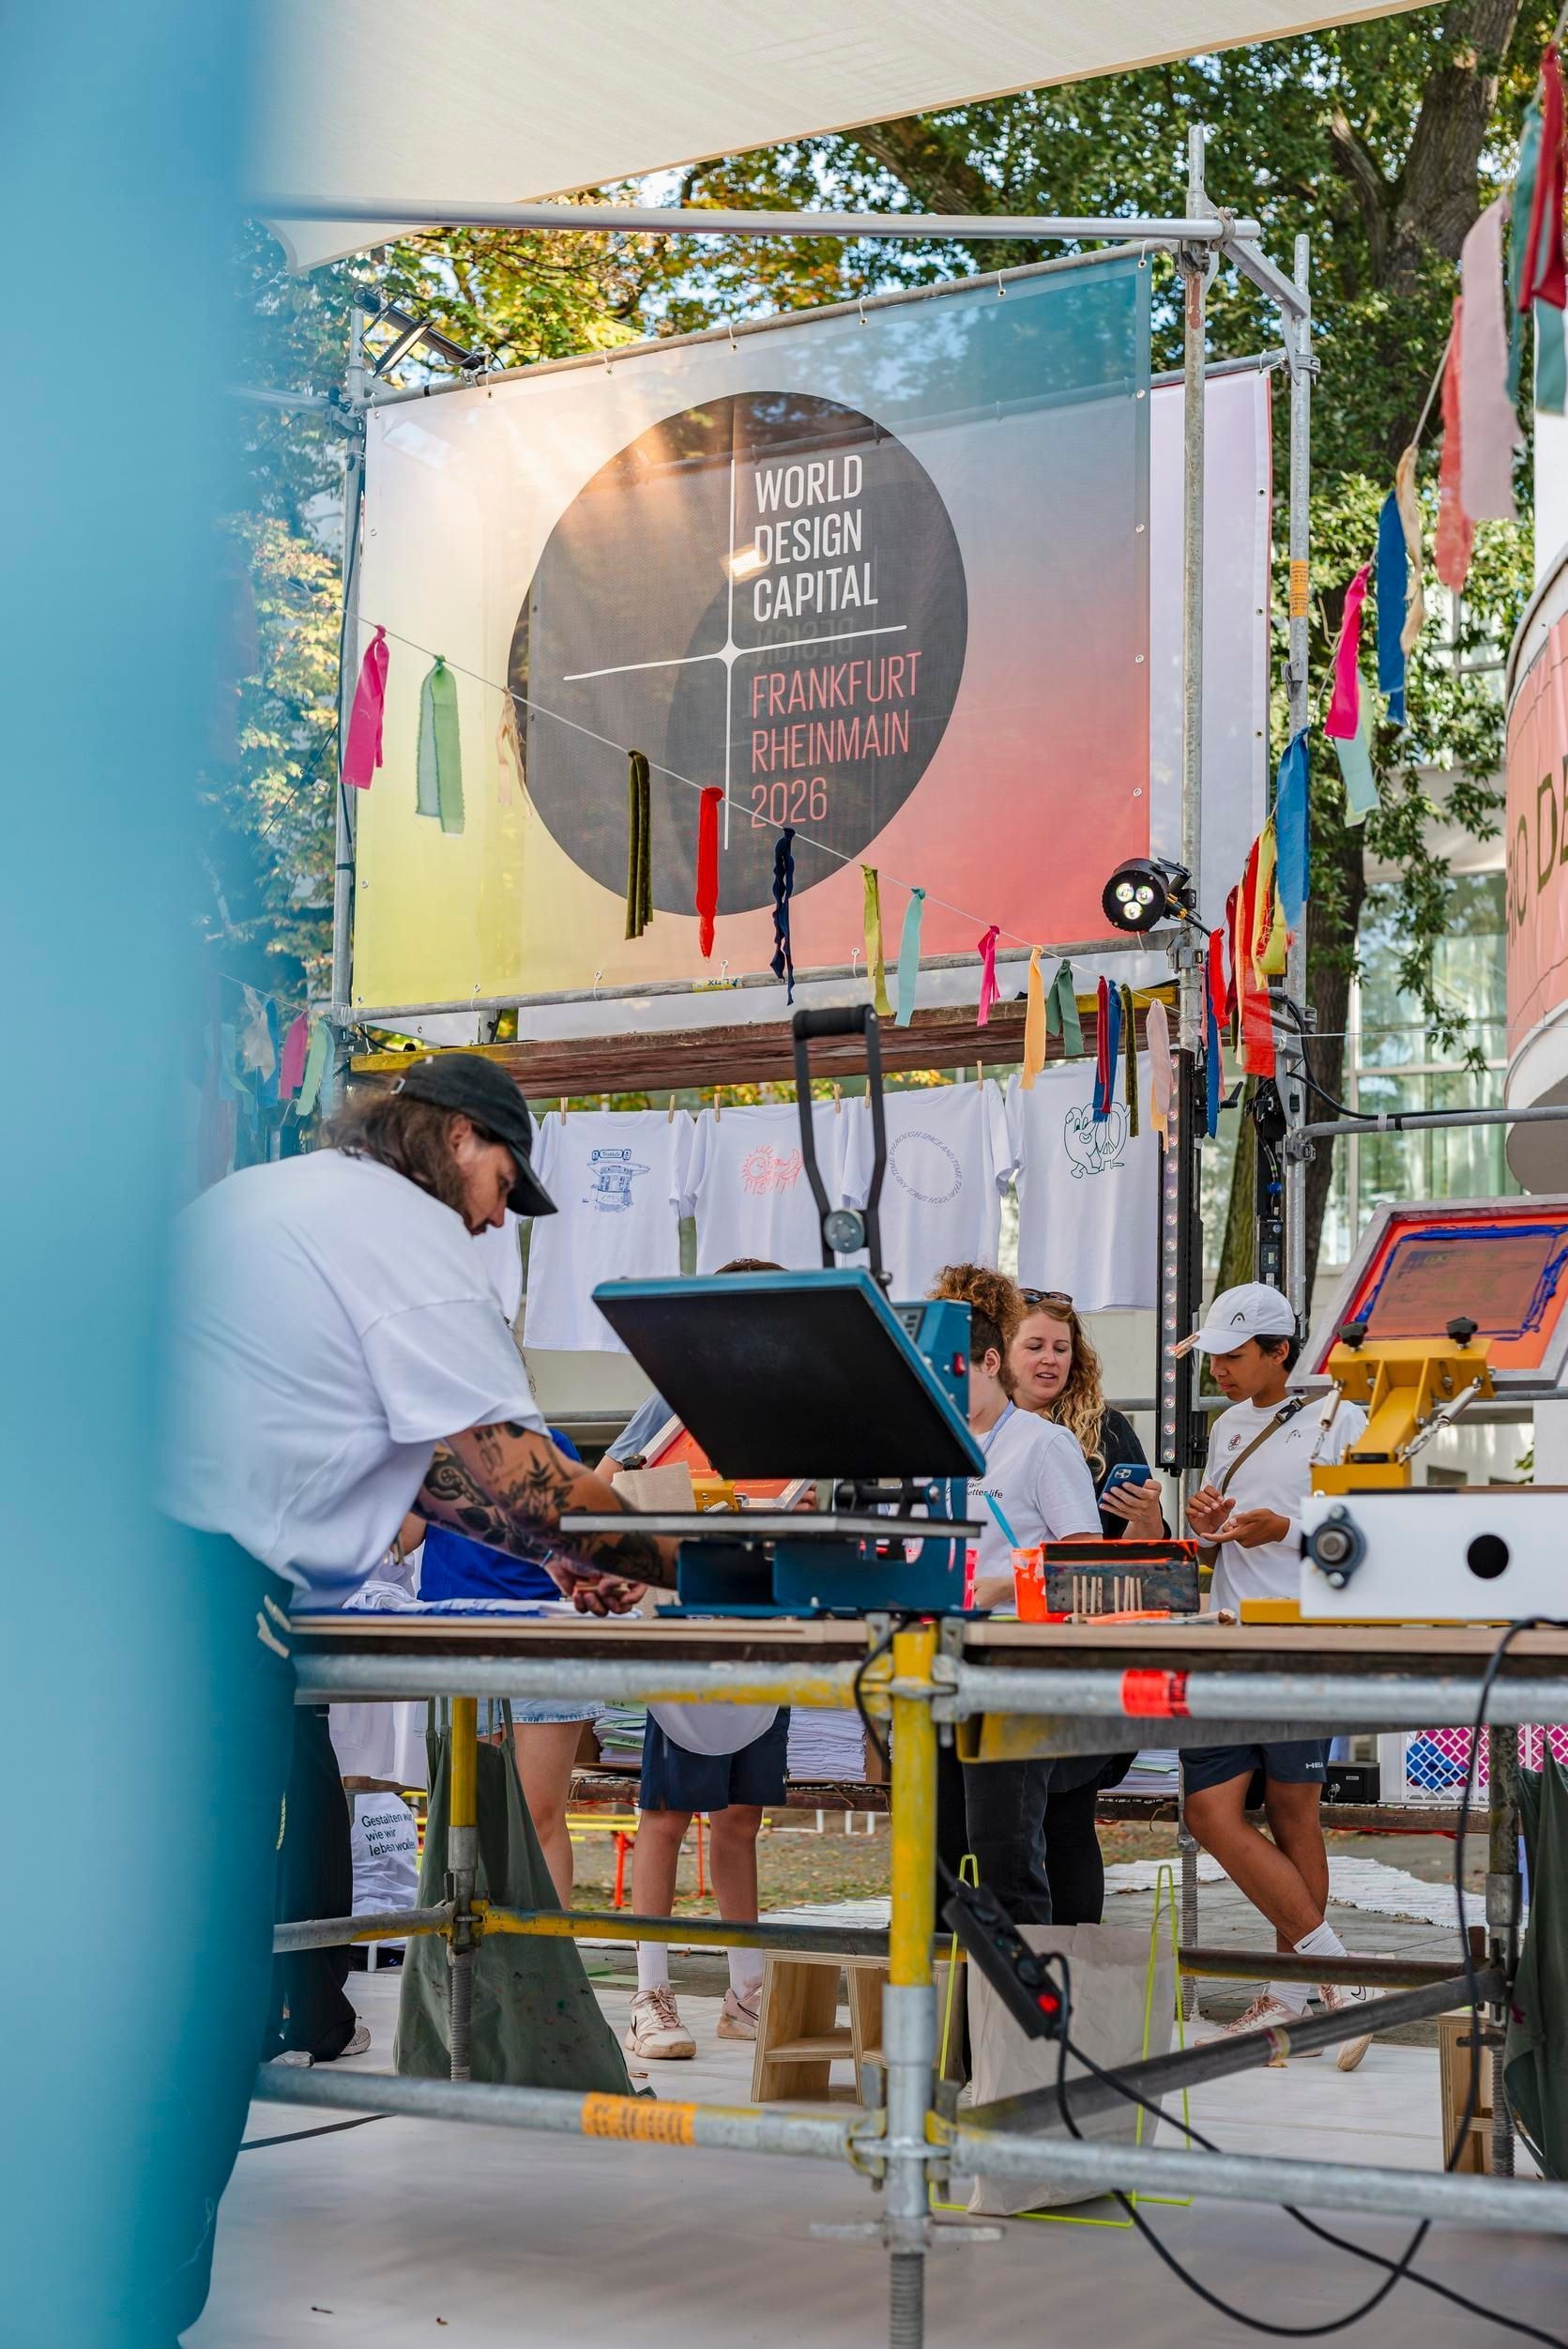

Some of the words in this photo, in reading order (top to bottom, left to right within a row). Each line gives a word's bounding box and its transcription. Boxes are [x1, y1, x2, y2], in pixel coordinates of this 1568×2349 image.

[754, 454, 862, 513] WORLD
[754, 509, 862, 567] DESIGN
[754, 562, 878, 622] CAPITAL
[753, 650, 922, 719] FRANKFURT
[753, 709, 909, 773] RHEINMAIN
[751, 776, 827, 829] 2026
[921, 1133, 943, 1147] SPACE
[940, 1145, 955, 1161] AND
[989, 1489, 1003, 1499] life
[361, 1813, 403, 1827] Gestalten
[366, 1829, 384, 1841] wie
[383, 1827, 396, 1838] wir
